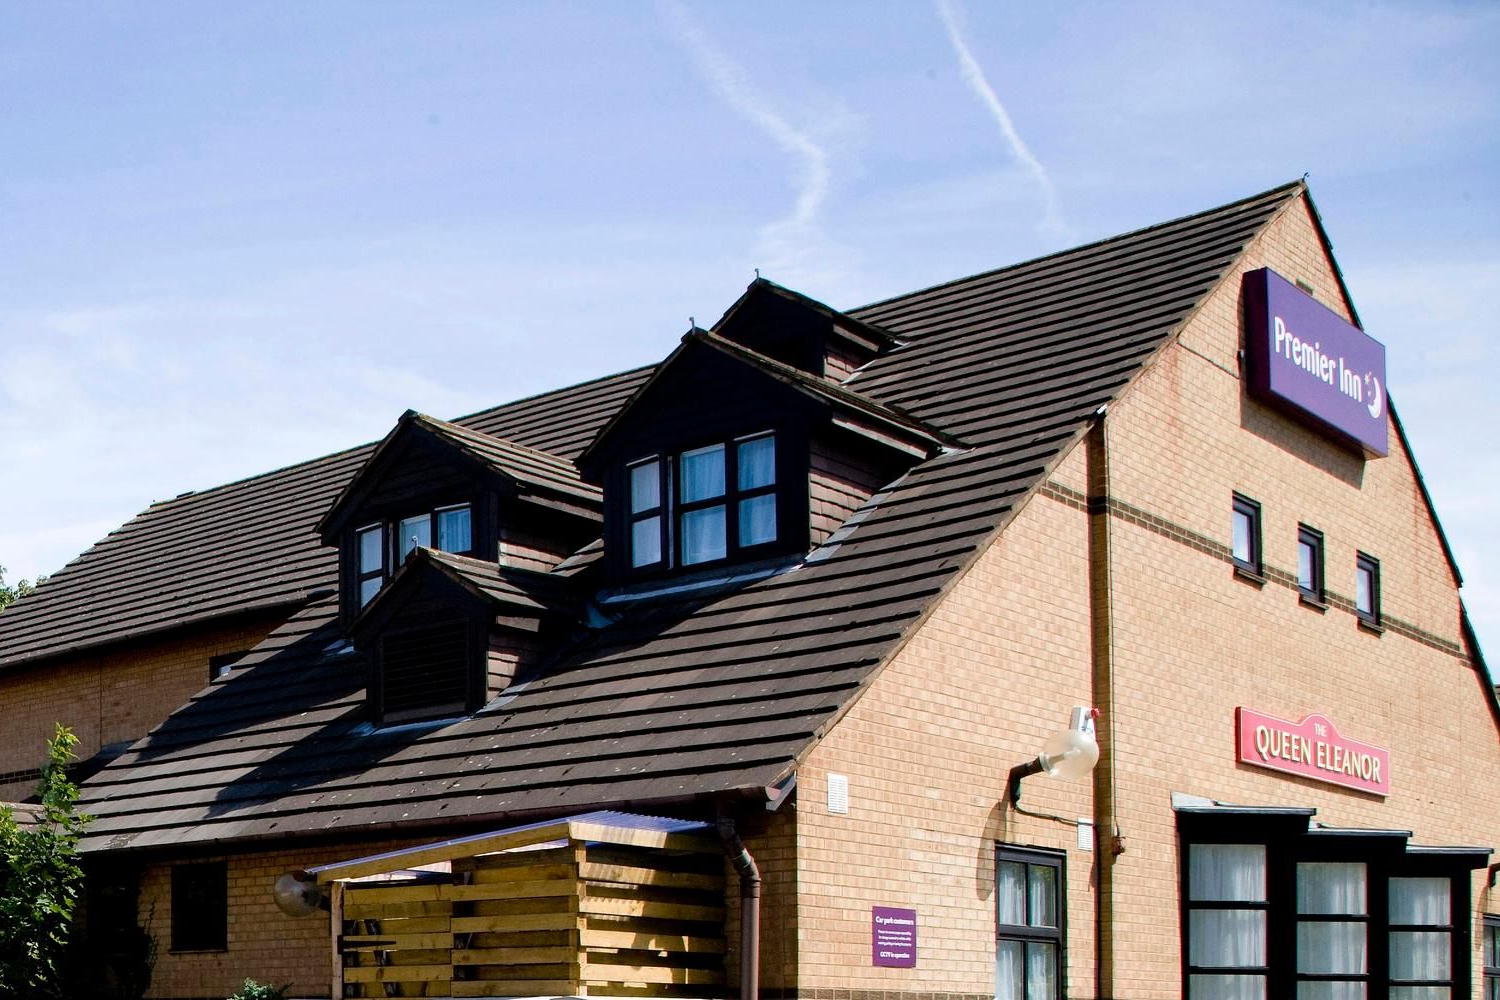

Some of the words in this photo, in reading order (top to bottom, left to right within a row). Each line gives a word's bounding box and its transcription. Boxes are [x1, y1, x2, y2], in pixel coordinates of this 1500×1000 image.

[1274, 316, 1336, 385] Premier
[1338, 357, 1362, 402] Inn
[1255, 725, 1311, 765] QUEEN
[1316, 741, 1381, 784] ELEANOR
[1314, 723, 1327, 737] THE
